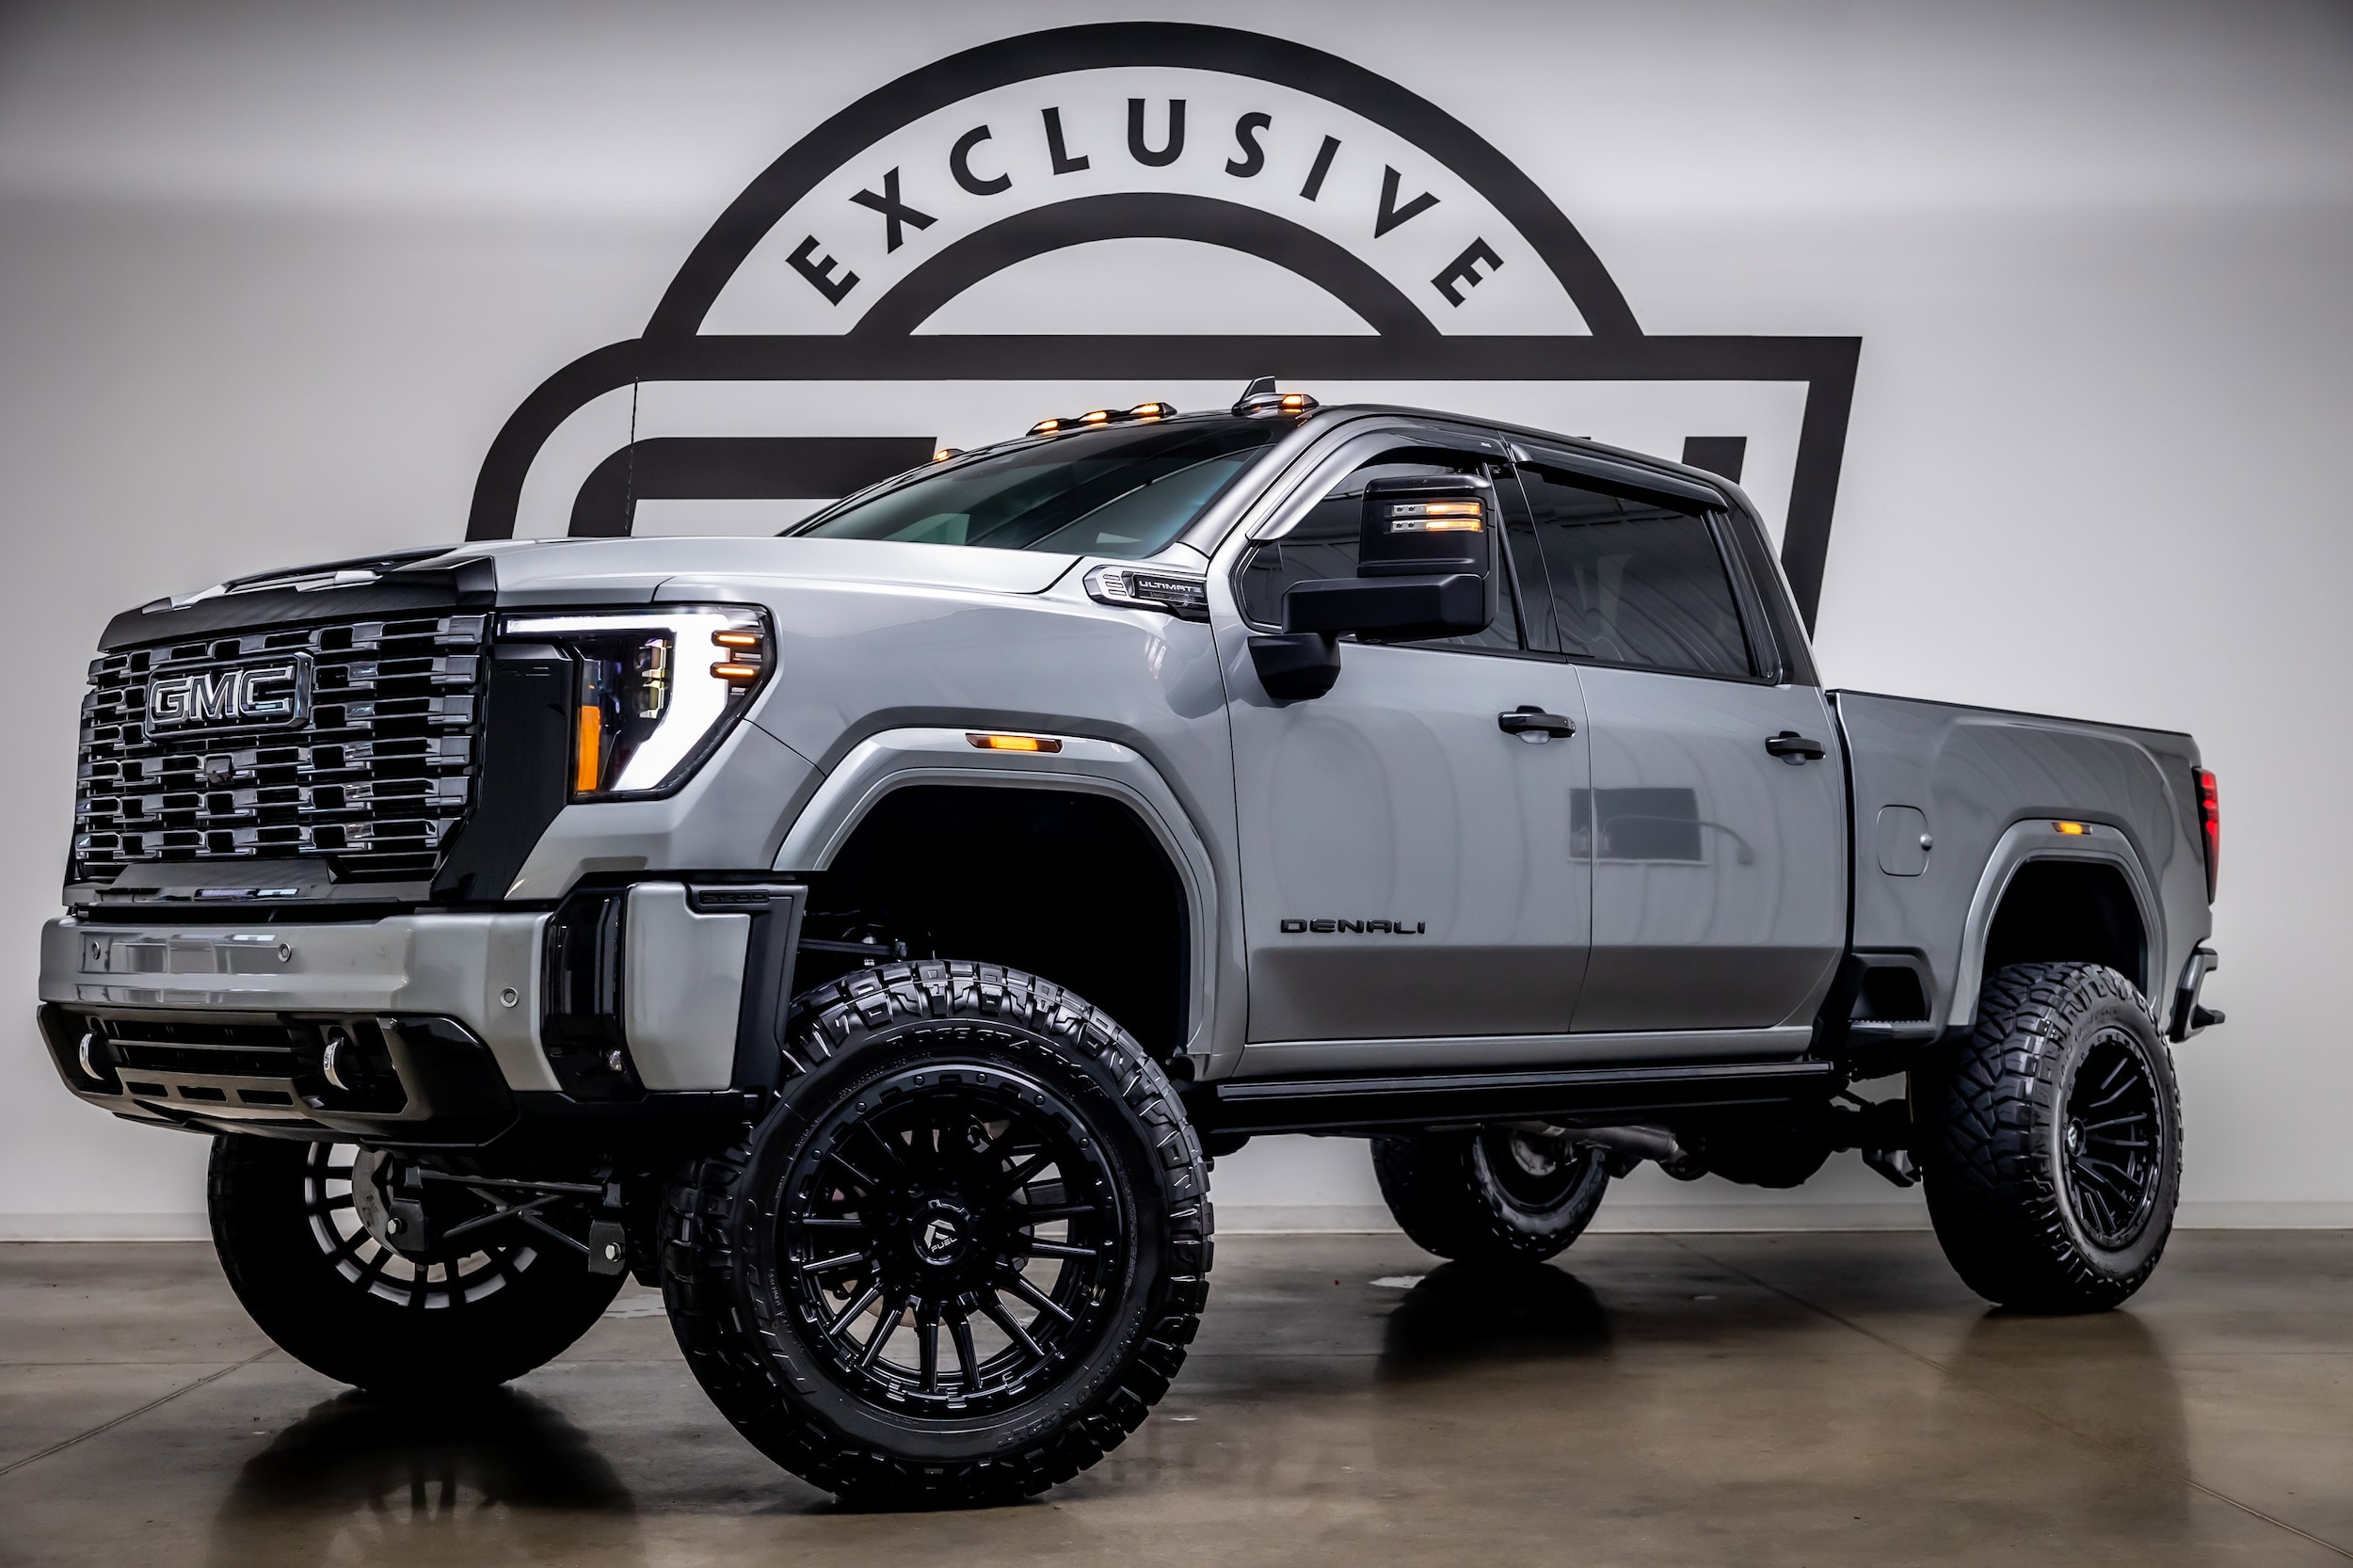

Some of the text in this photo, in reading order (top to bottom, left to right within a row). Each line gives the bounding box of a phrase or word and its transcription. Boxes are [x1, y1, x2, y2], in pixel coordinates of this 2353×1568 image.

[785, 98, 1505, 308] EXCLUSIVE
[1139, 580, 1202, 593] ULTIMATE
[149, 664, 295, 726] GMC
[1280, 919, 1426, 935] DENALI
[931, 1237, 958, 1254] FUEL
